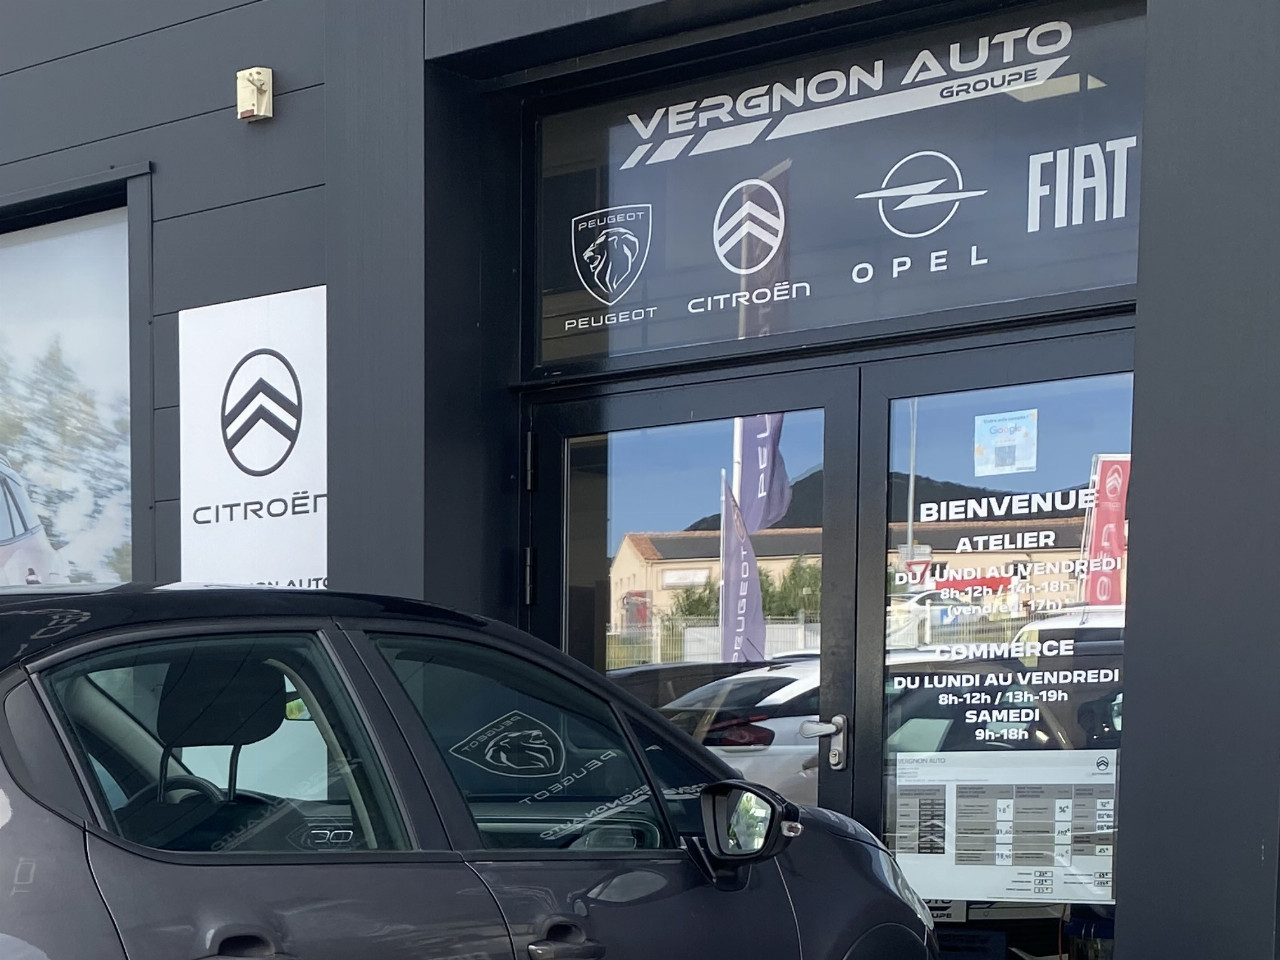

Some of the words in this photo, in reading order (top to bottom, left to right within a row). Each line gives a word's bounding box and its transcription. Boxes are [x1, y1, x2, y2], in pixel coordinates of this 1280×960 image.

[627, 60, 884, 139] VERGNON
[901, 21, 1073, 86] AUTO
[939, 68, 1038, 99] GROUPE
[1027, 136, 1137, 233] FIAT
[578, 211, 645, 231] PEUGEOT
[852, 245, 989, 284] OPEL
[565, 306, 658, 331] PEUGEOT
[920, 488, 1099, 522] BIENVENUE
[955, 530, 1056, 553] ATELIER
[895, 573, 920, 586] DU
[924, 566, 981, 584] LUNDI
[986, 564, 1014, 580] AU
[1017, 556, 1122, 577] VENDREDI
[940, 586, 993, 600] 8h-12h
[935, 639, 1075, 660] COMMERCE
[894, 675, 920, 690] DU
[924, 672, 981, 689] LUNDI
[984, 671, 1013, 687] AU
[1016, 667, 1120, 686] VENDREDI
[938, 690, 992, 705] 8h-12h
[994, 690, 1002, 703] /
[1005, 688, 1069, 702] 13h-19h
[965, 708, 1040, 723] SAMEDI
[974, 727, 1029, 741] 9h-18h
